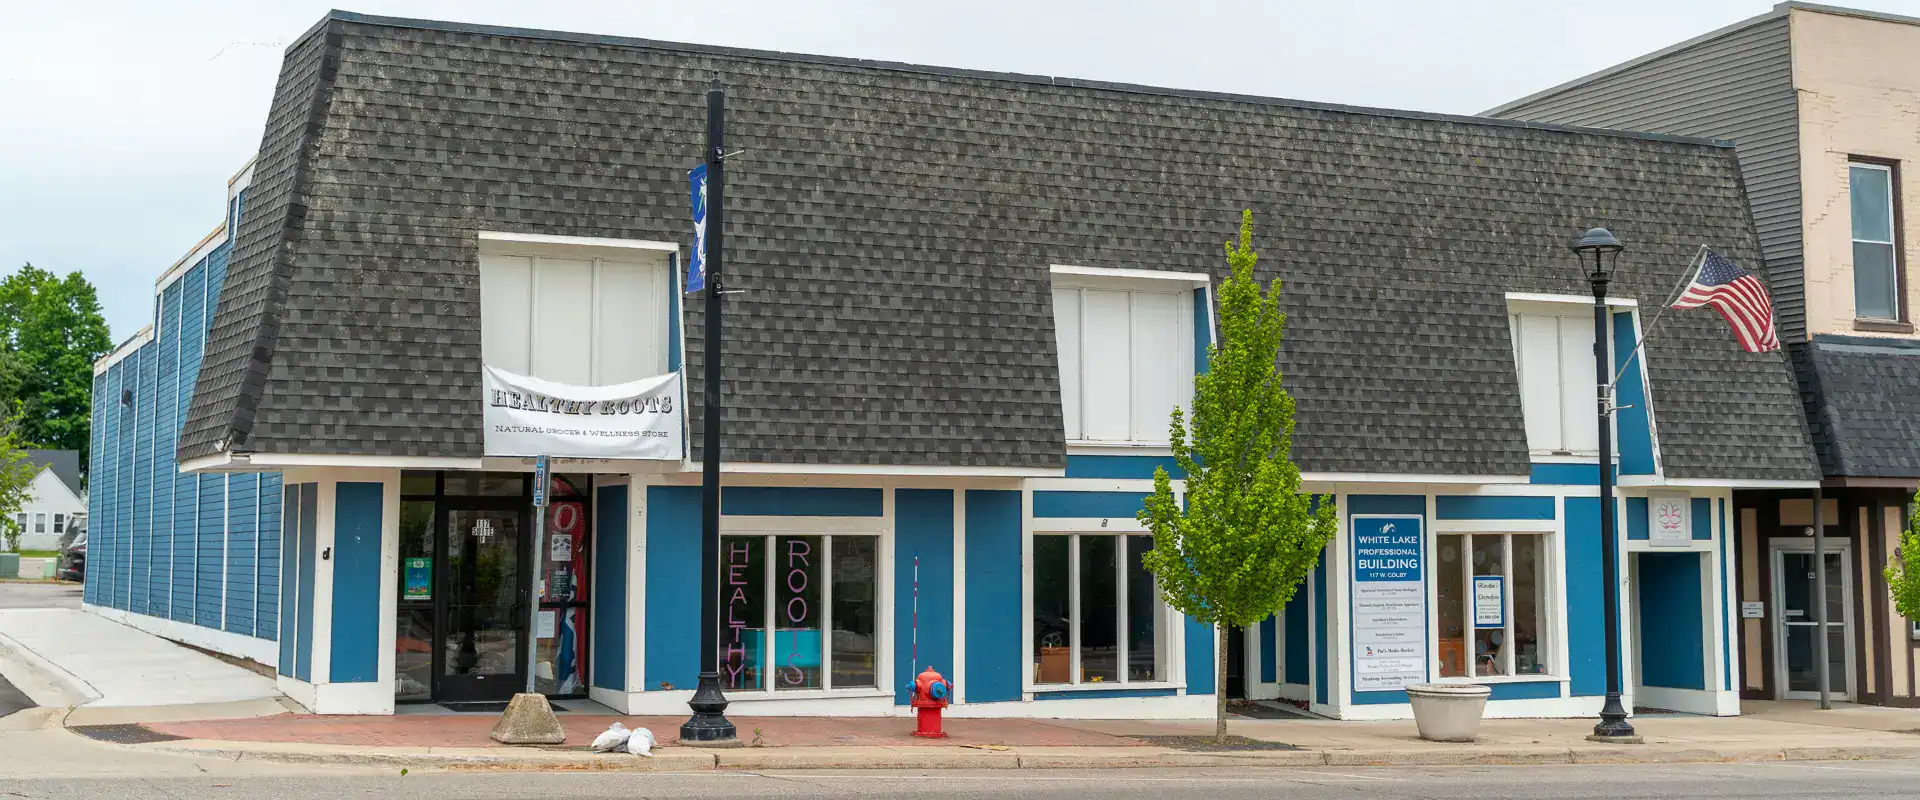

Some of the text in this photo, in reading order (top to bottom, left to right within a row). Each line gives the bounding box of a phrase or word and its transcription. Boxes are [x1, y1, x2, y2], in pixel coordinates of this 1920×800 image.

[490, 388, 673, 416] HEALTHY ROOTS
[495, 425, 544, 434] NATURAL
[546, 428, 581, 436] GROCER
[589, 430, 640, 438] WELLNESS
[642, 430, 669, 438] STORE
[477, 519, 490, 527] 117
[472, 527, 493, 535] SUITE
[1358, 536, 1417, 544] WHITE LAKE
[1358, 559, 1418, 569] BUILDING
[726, 541, 750, 688] HEALTHY
[784, 540, 811, 685] ROOTS
